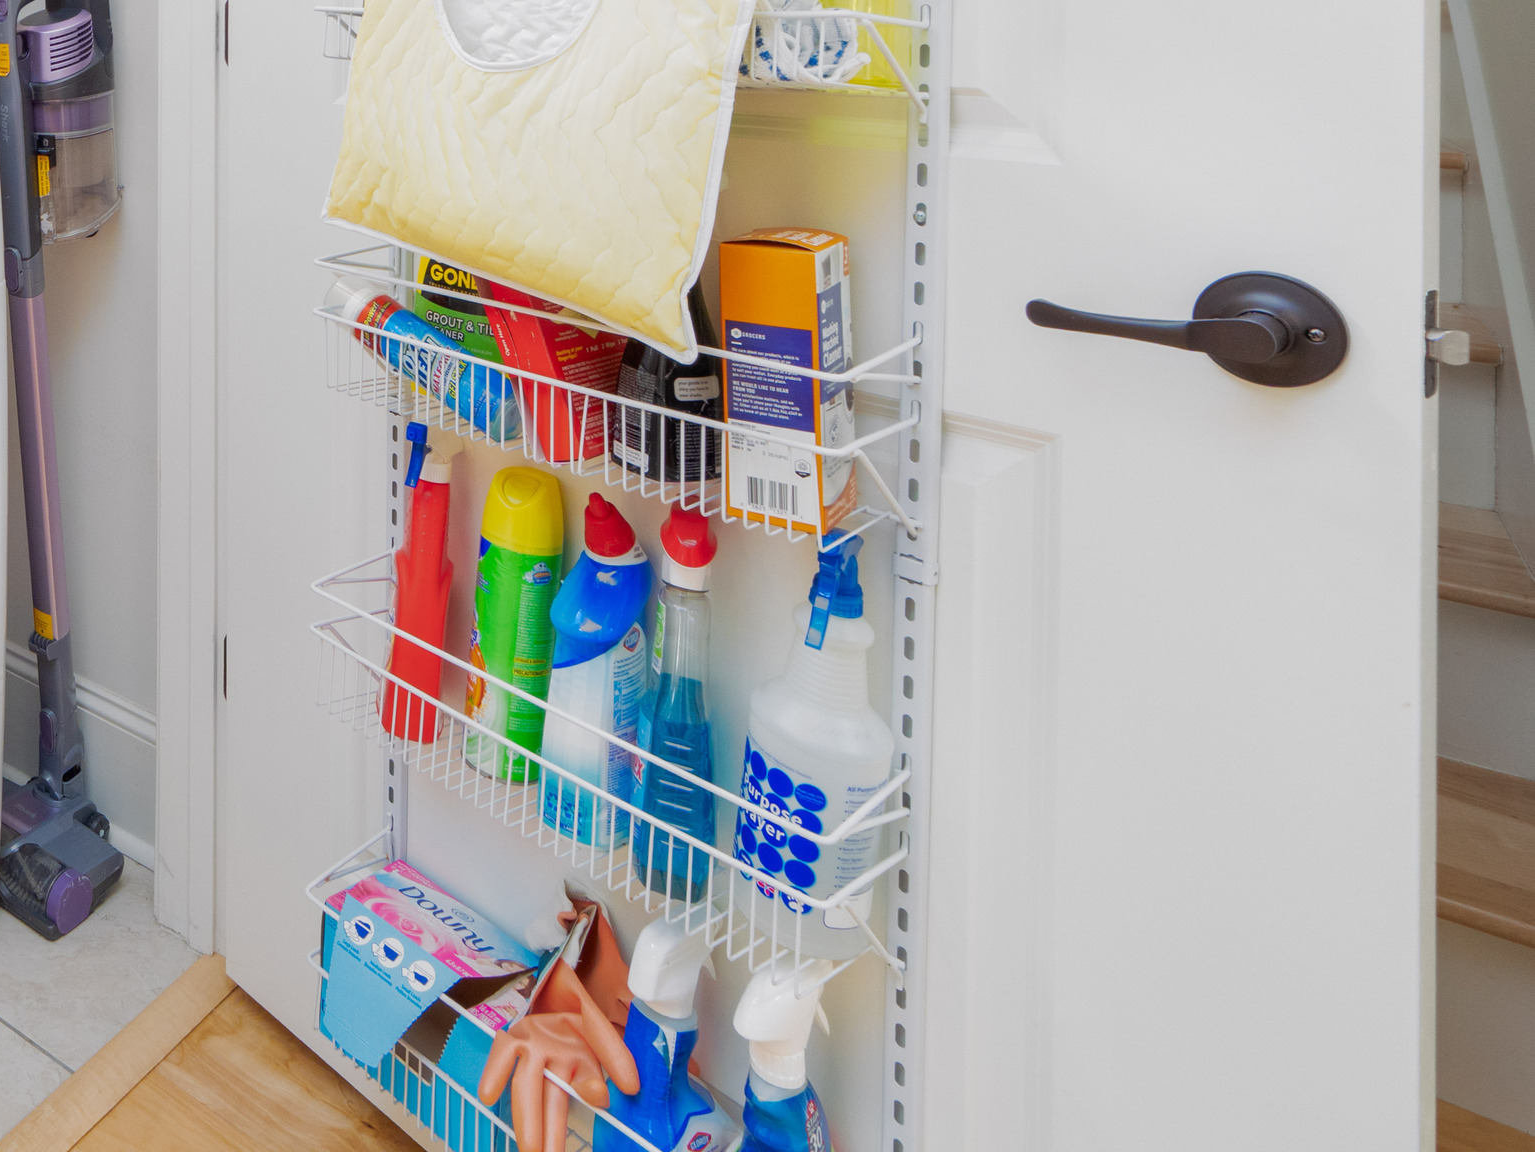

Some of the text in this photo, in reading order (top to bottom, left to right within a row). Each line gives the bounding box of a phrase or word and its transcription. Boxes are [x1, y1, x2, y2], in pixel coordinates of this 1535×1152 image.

[0, 104, 10, 144] Shark
[426, 310, 494, 336] GROUT & TIL
[434, 326, 464, 341] EANER
[742, 332, 766, 340] GROCERS
[496, 323, 511, 356] Open Here
[398, 886, 495, 952] Downy
[689, 1134, 710, 1151] CLOROX
